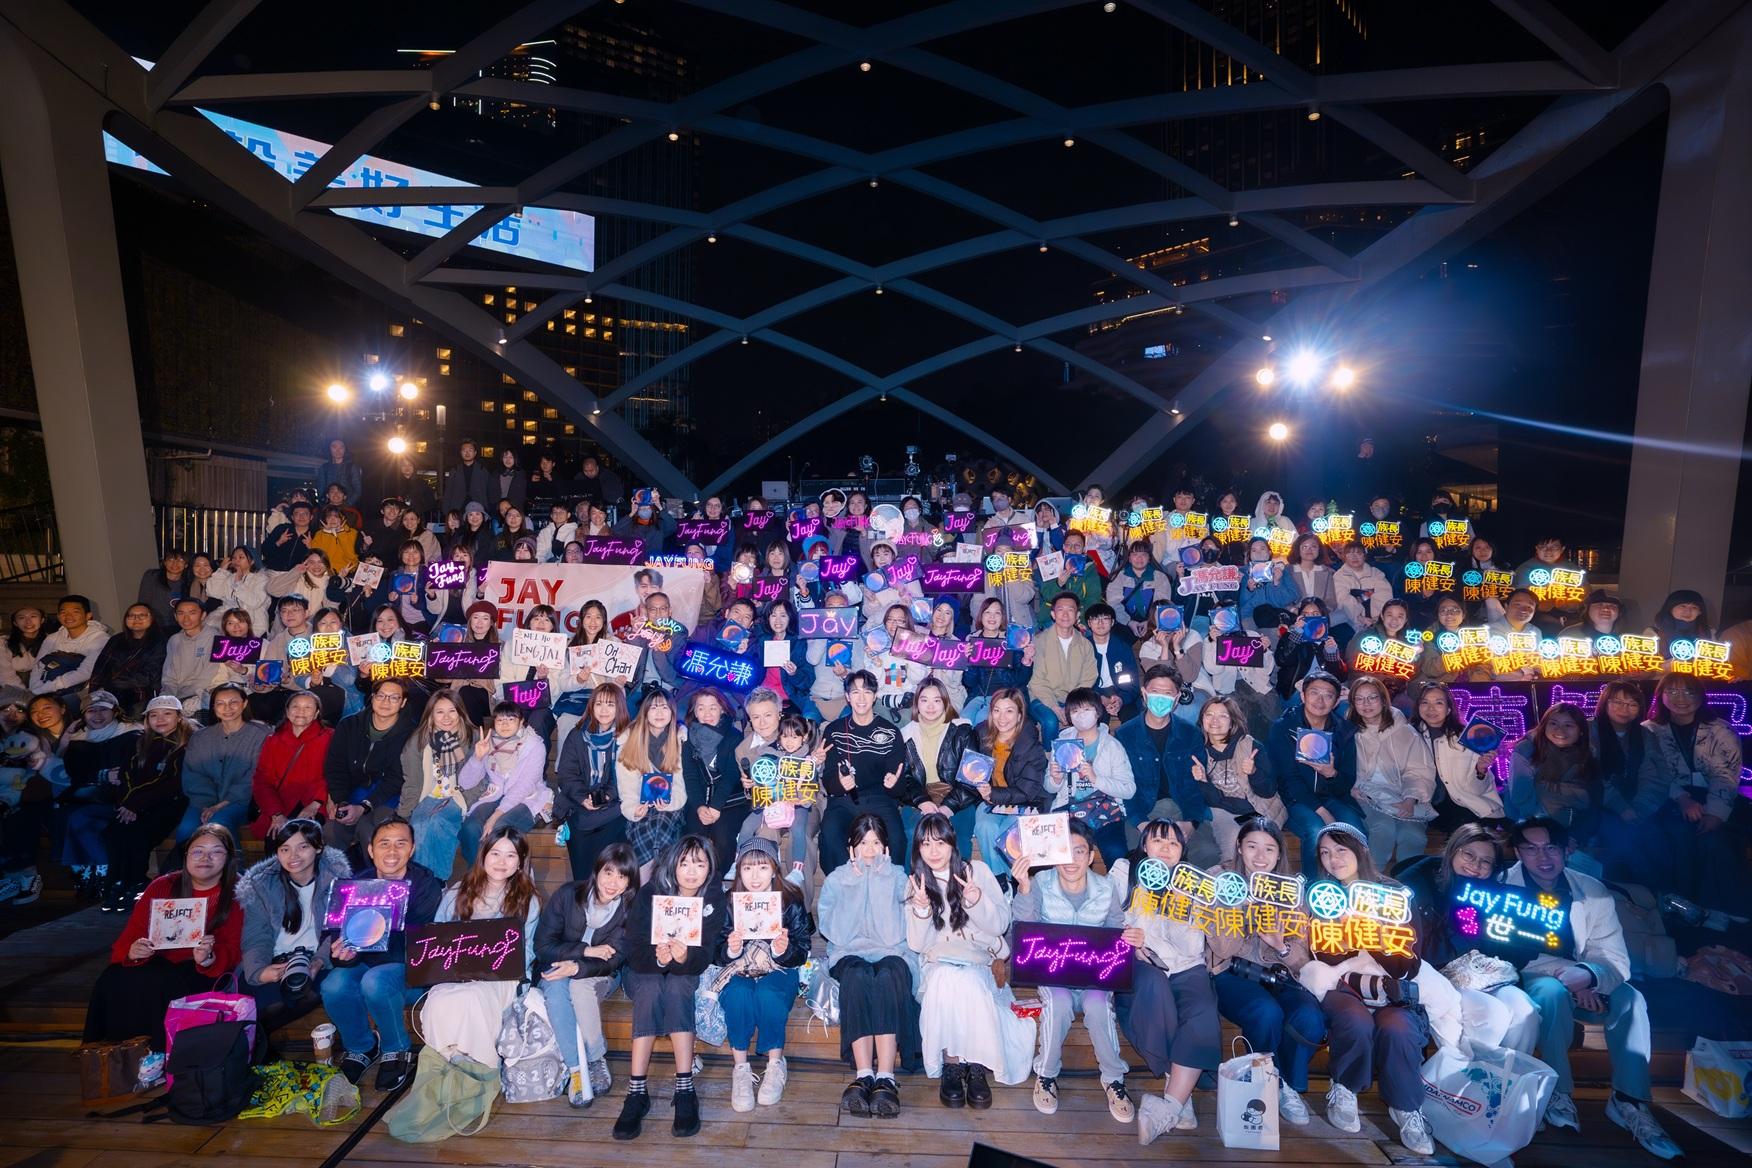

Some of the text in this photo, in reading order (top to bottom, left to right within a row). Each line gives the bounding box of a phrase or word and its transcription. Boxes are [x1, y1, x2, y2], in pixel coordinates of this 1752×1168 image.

[744, 511, 769, 529] Jay
[945, 515, 968, 532] Jay
[1377, 522, 1399, 533] 族長
[1445, 521, 1467, 533] 族長
[677, 523, 728, 544] JayFung
[792, 523, 815, 539] Jay
[1361, 533, 1403, 549] 陳健安
[585, 540, 642, 564] JayFung
[1005, 553, 1029, 566] 族長
[429, 562, 458, 578] Jay
[821, 558, 850, 578] Jay
[888, 564, 916, 585] Jay
[925, 570, 979, 587] JayFung
[988, 567, 1032, 586] 陳健安
[1426, 562, 1452, 575] 族長
[1486, 572, 1512, 584] 族長
[1554, 570, 1583, 584] 族長
[435, 571, 465, 588] Fung
[754, 580, 780, 599] Jay
[1405, 576, 1456, 593] 陳健安
[499, 578, 564, 605] JAY
[496, 607, 581, 633] FUG
[800, 613, 857, 638] Jay
[313, 635, 341, 649] 族長
[1461, 629, 1488, 644] 族長
[1623, 636, 1656, 652] 族長
[213, 640, 251, 661] Jay
[394, 645, 421, 658] 族長
[970, 641, 1004, 665] Jay
[1218, 640, 1255, 664] Jay
[1385, 643, 1416, 660] 族長
[1442, 646, 1496, 672] 陳健安
[1698, 642, 1729, 659] 族長
[291, 649, 348, 677] 陳健安
[371, 659, 425, 680] 陳健安
[428, 650, 496, 673] JayFung
[682, 649, 753, 687] 馮允謙
[1355, 652, 1415, 680] 陳健安
[1541, 655, 1598, 678] 陳健安
[1600, 652, 1664, 674] 陳健安
[780, 758, 814, 779] 族長
[752, 781, 819, 808] 陳健安
[1032, 824, 1057, 836] REJECT
[1173, 867, 1216, 900] 族長
[1254, 874, 1298, 904] 族長
[665, 907, 690, 918] REJECT
[745, 901, 770, 912] REJECT
[1131, 887, 1217, 935] 陳健安
[1354, 885, 1406, 920] 族長
[1456, 882, 1565, 930] Jay Fung
[164, 908, 193, 919] REJECT
[1215, 902, 1308, 939] 陳健安
[1311, 916, 1415, 956] 陳健安
[1486, 913, 1545, 942] 世一
[410, 934, 516, 970] JayFung
[1016, 937, 1126, 980] JayFung
[1443, 1095, 1476, 1112] NAMCO
